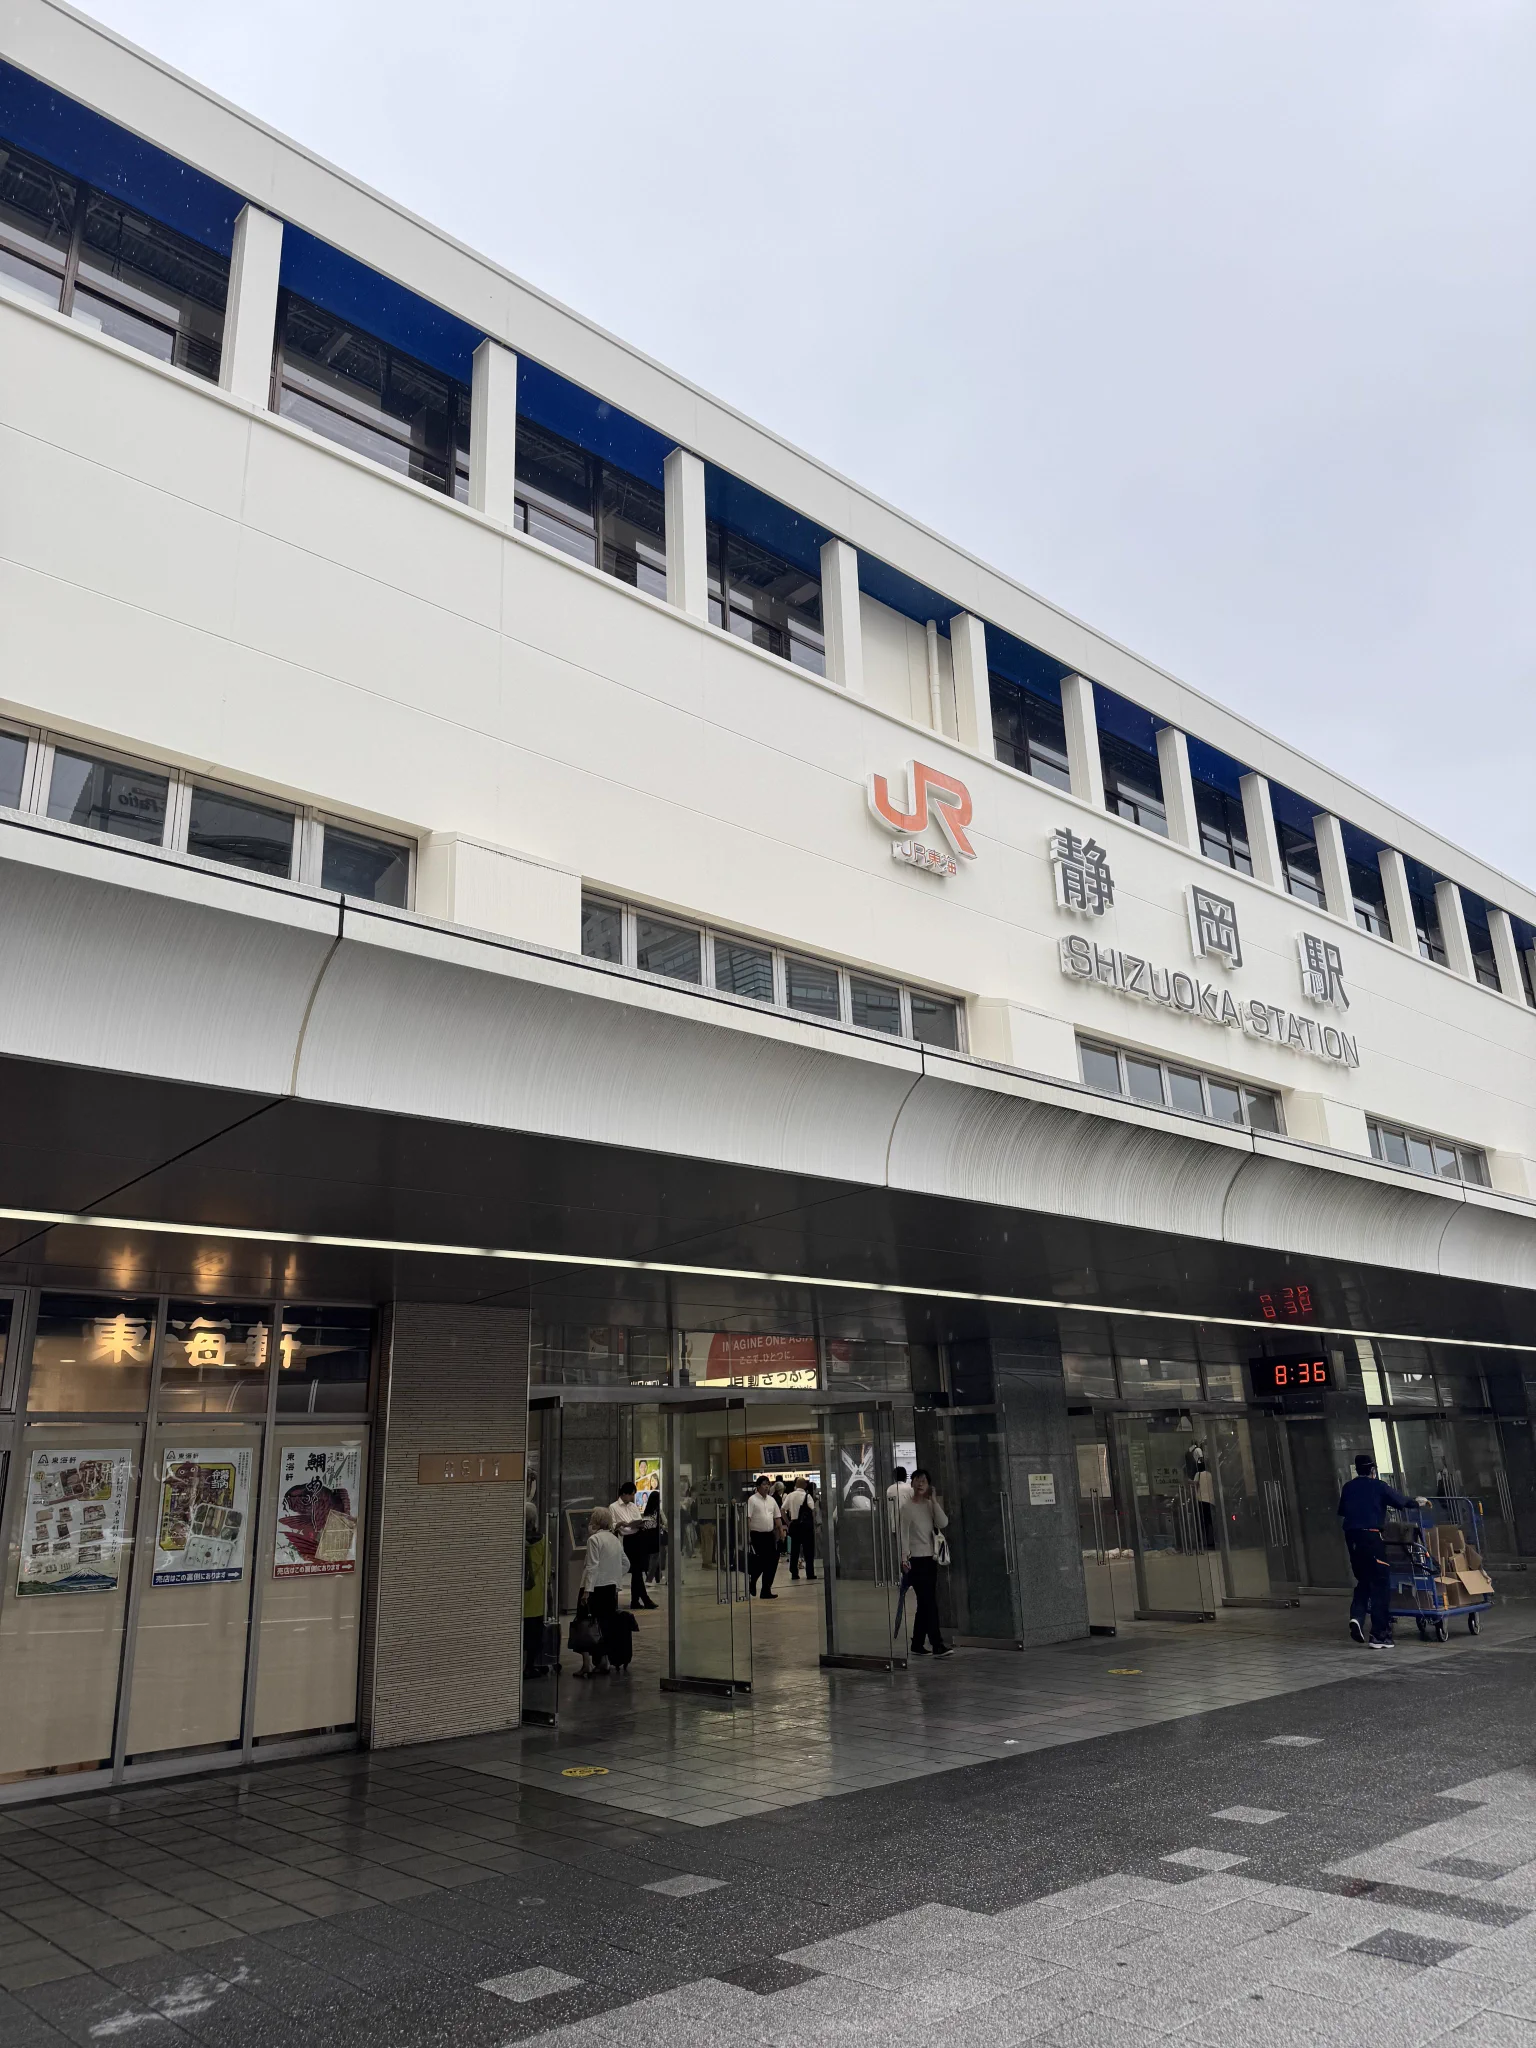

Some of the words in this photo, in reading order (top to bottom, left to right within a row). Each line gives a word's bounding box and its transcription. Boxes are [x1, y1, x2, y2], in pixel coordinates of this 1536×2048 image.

[870, 760, 977, 859] JR
[898, 840, 957, 876] JR東海
[1050, 827, 1351, 1012] 静岡駅
[1065, 934, 1242, 1028] SHIZUOKA
[1248, 999, 1360, 1068] STATION
[92, 1313, 302, 1368] 東海軒
[1275, 1362, 1326, 1385] 8:36
[51, 1456, 77, 1464] 東海軒
[285, 1452, 295, 1481] 東海軒
